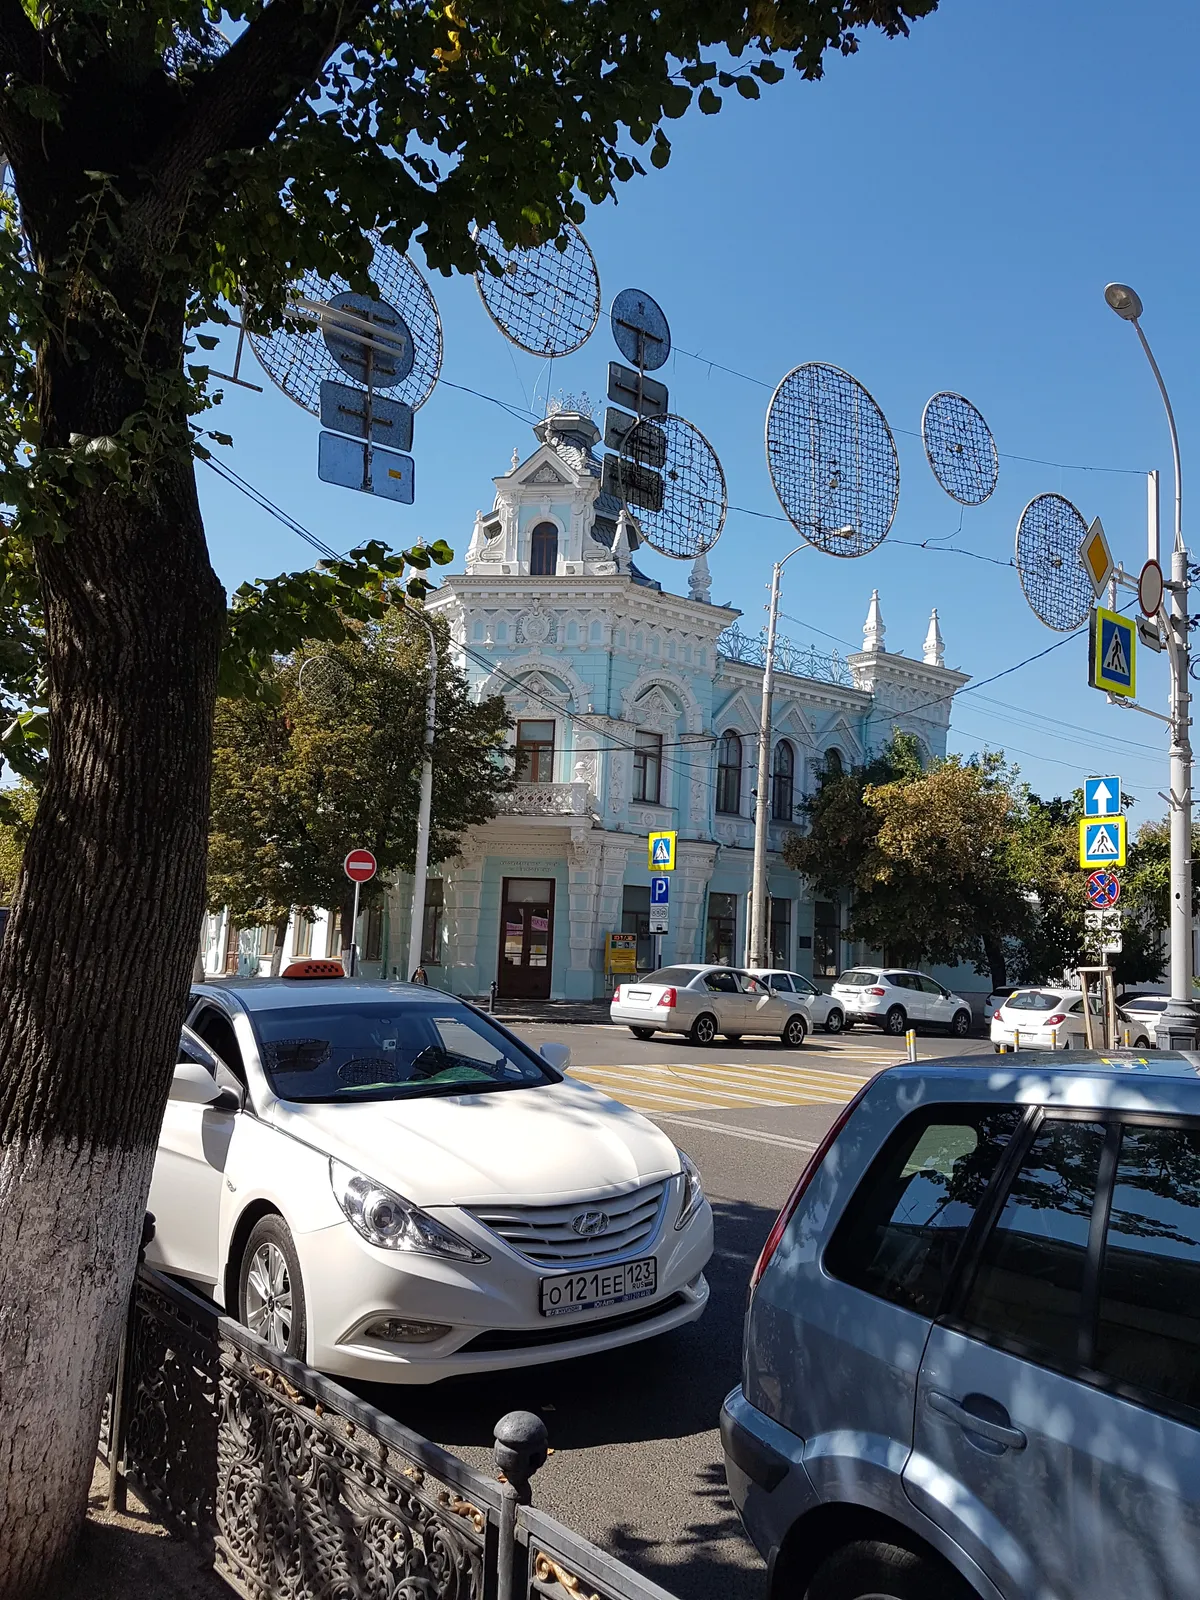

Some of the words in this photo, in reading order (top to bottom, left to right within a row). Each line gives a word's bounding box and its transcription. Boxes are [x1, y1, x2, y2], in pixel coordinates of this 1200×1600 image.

[656, 880, 666, 901] P
[627, 1262, 650, 1283] 123
[632, 1281, 644, 1290] RUS
